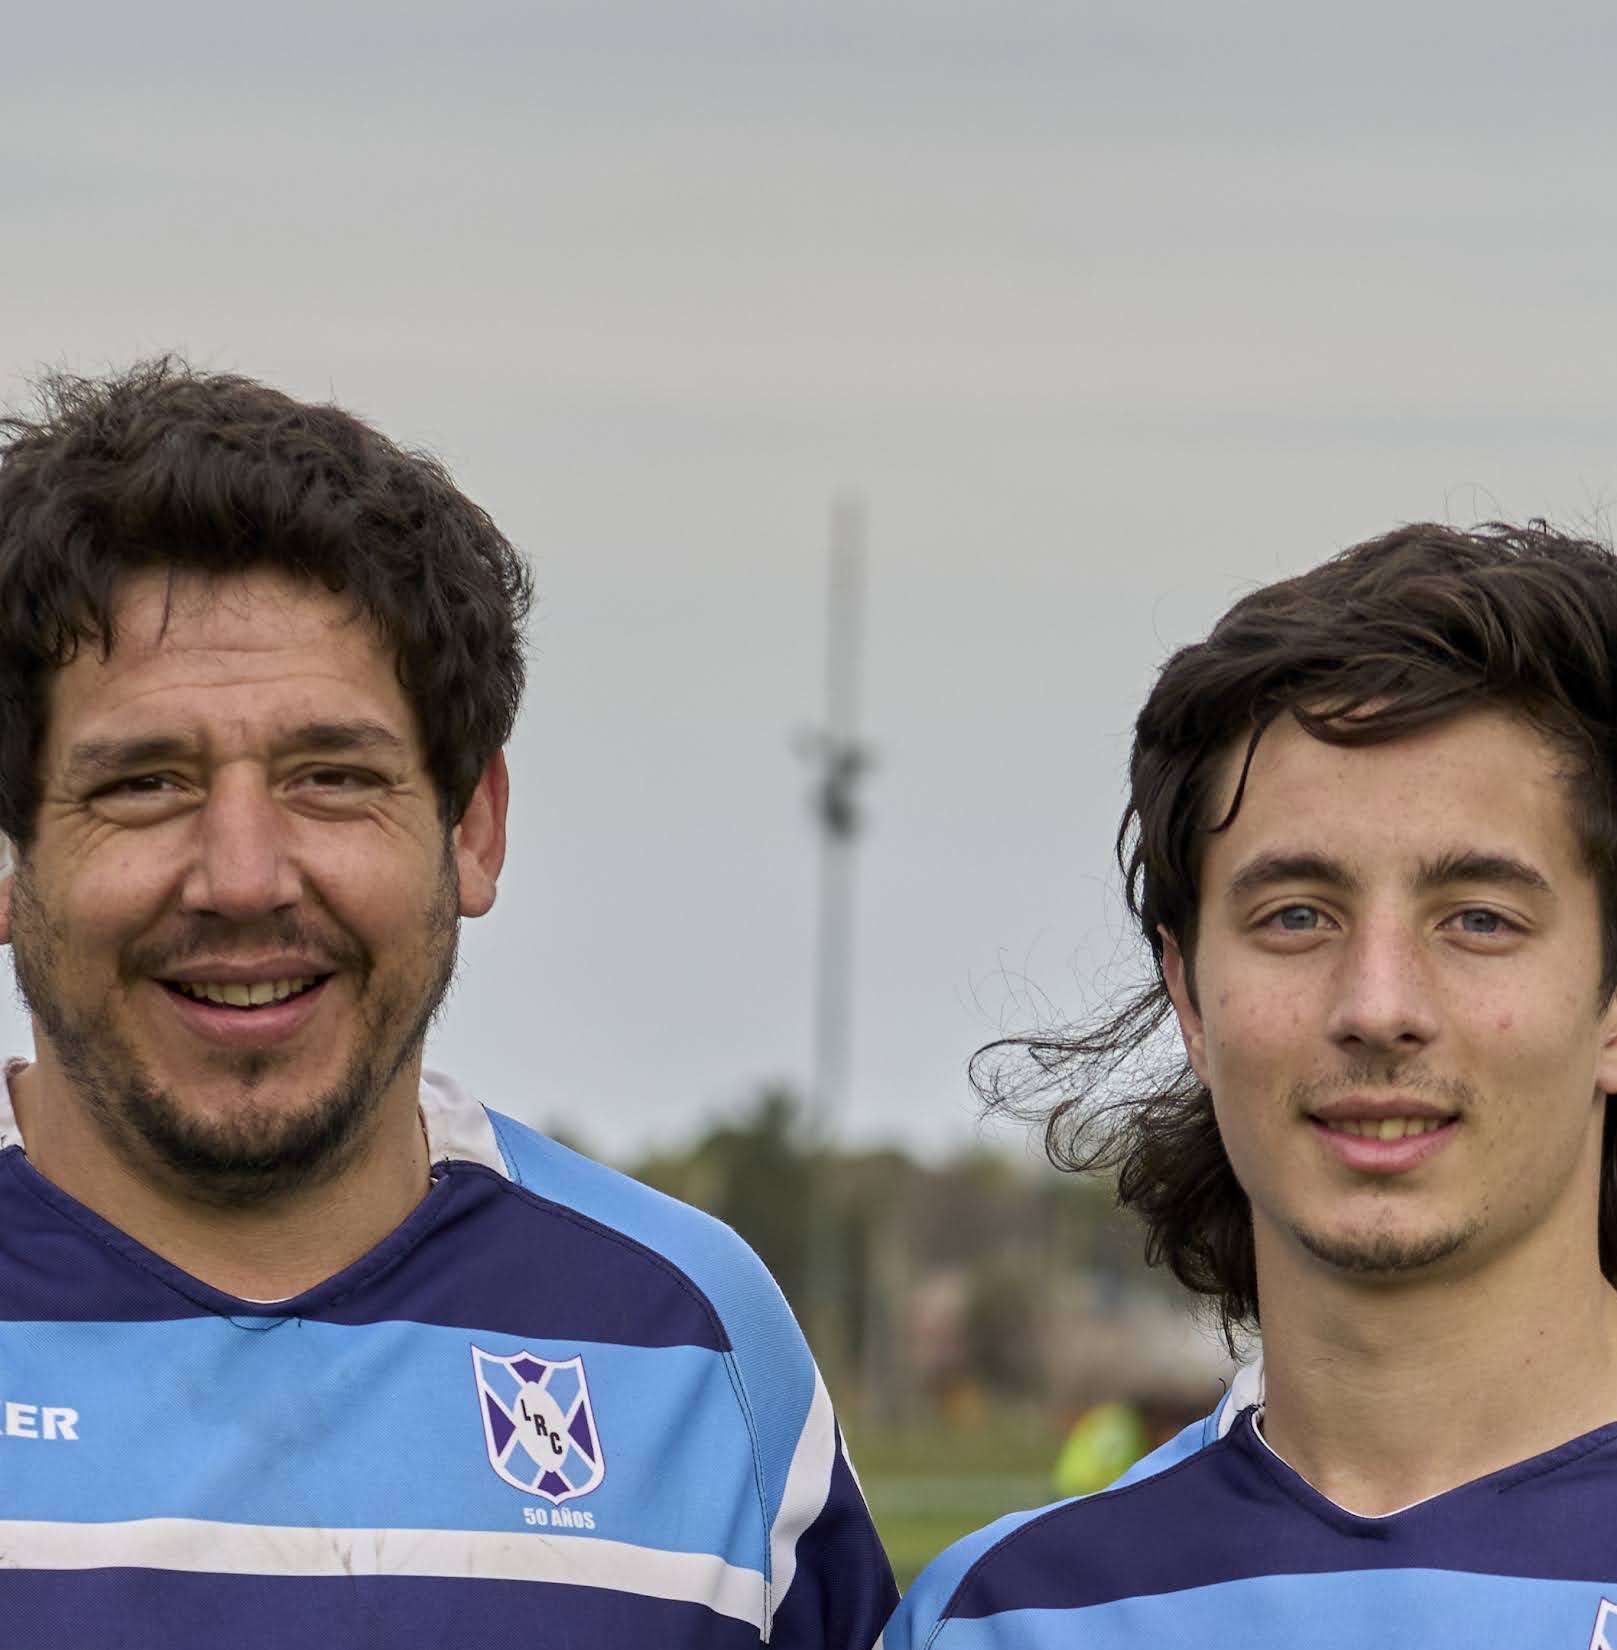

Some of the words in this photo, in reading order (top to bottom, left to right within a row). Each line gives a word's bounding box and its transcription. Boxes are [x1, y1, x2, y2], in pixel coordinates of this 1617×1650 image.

[520, 1398, 563, 1455] LRC
[523, 1507, 548, 1526] 50
[551, 1507, 597, 1530] AÑOS
